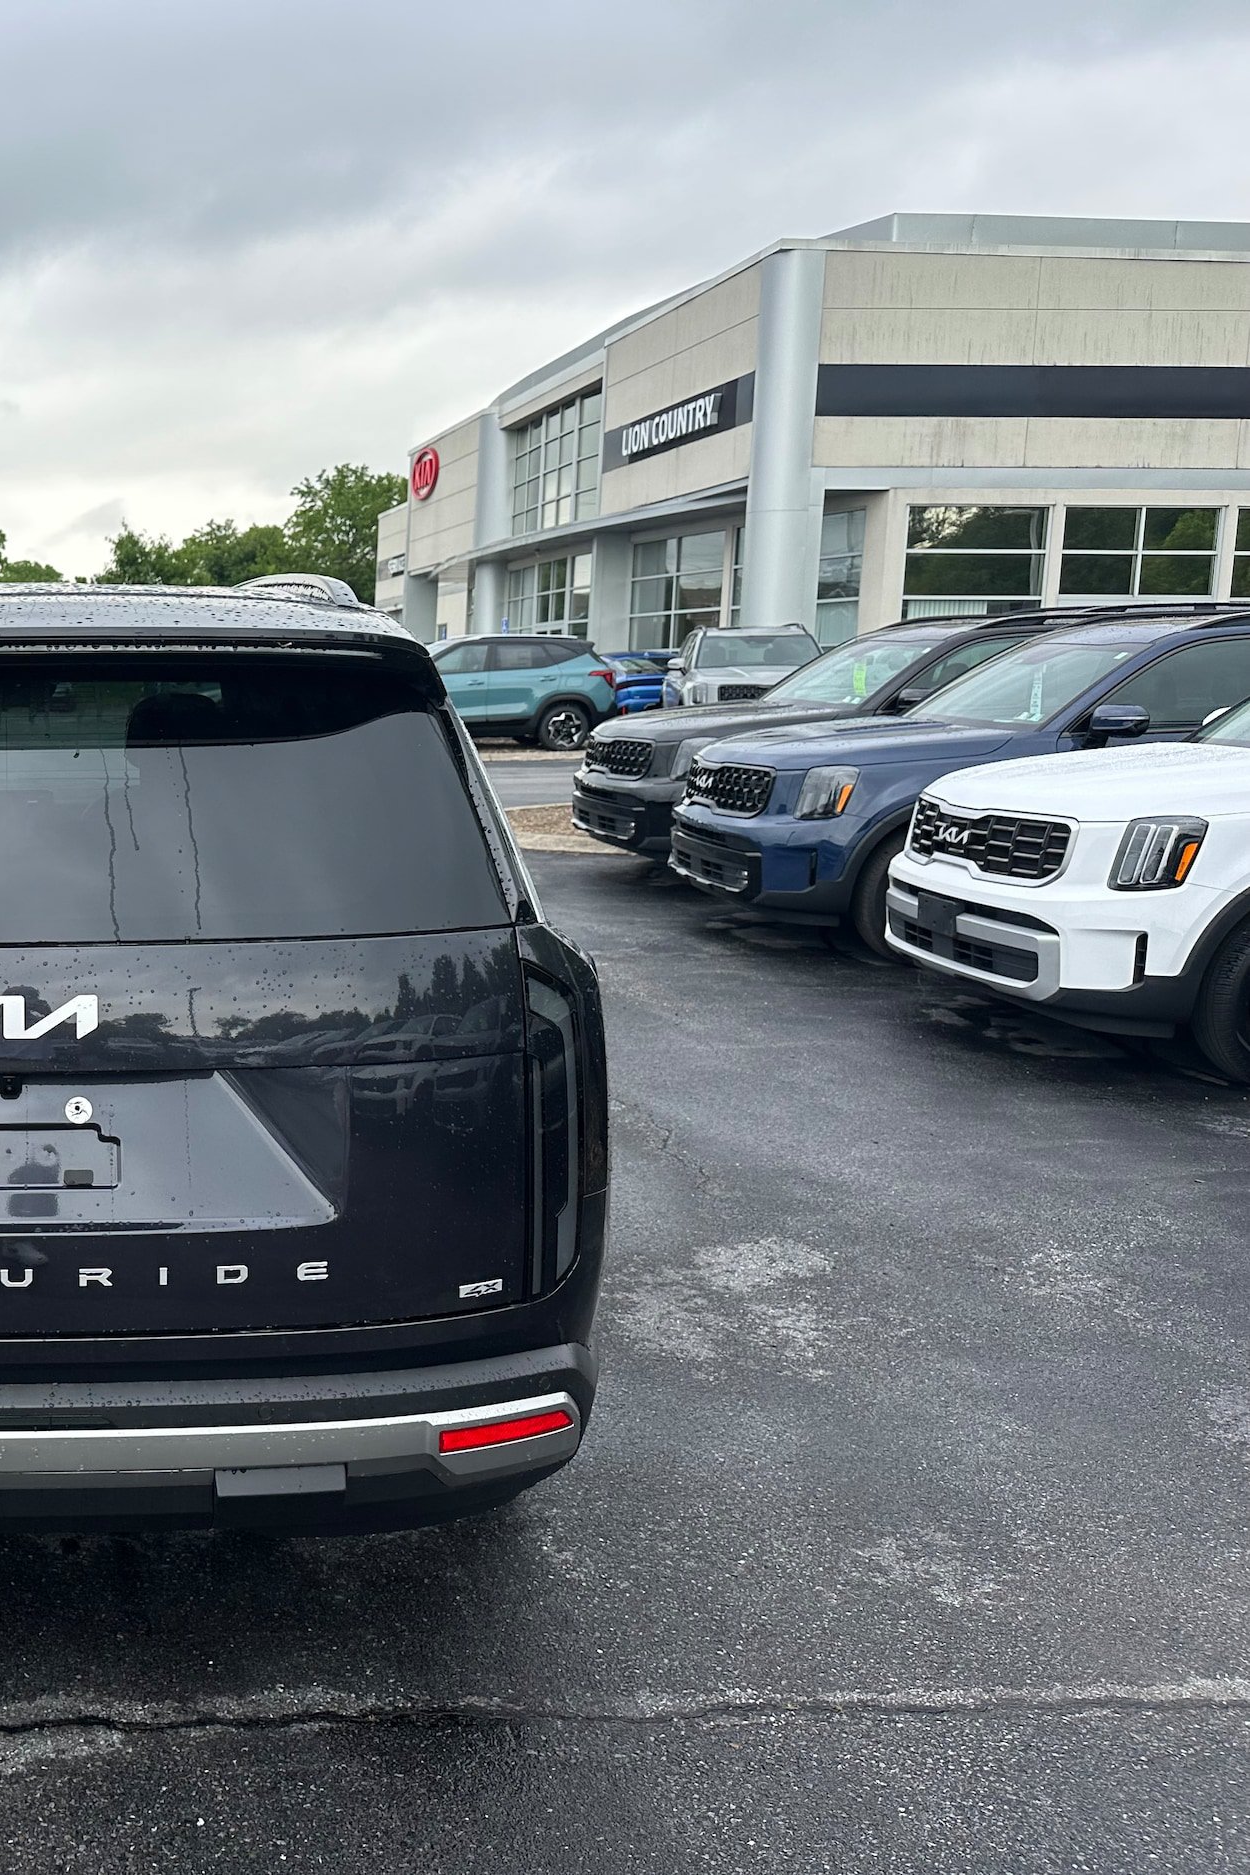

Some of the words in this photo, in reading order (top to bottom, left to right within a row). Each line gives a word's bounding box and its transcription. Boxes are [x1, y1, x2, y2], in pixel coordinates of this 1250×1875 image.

[622, 420, 650, 457] LION
[651, 393, 716, 446] COUNTRY
[414, 460, 431, 490] KIA
[936, 824, 971, 844] KIA
